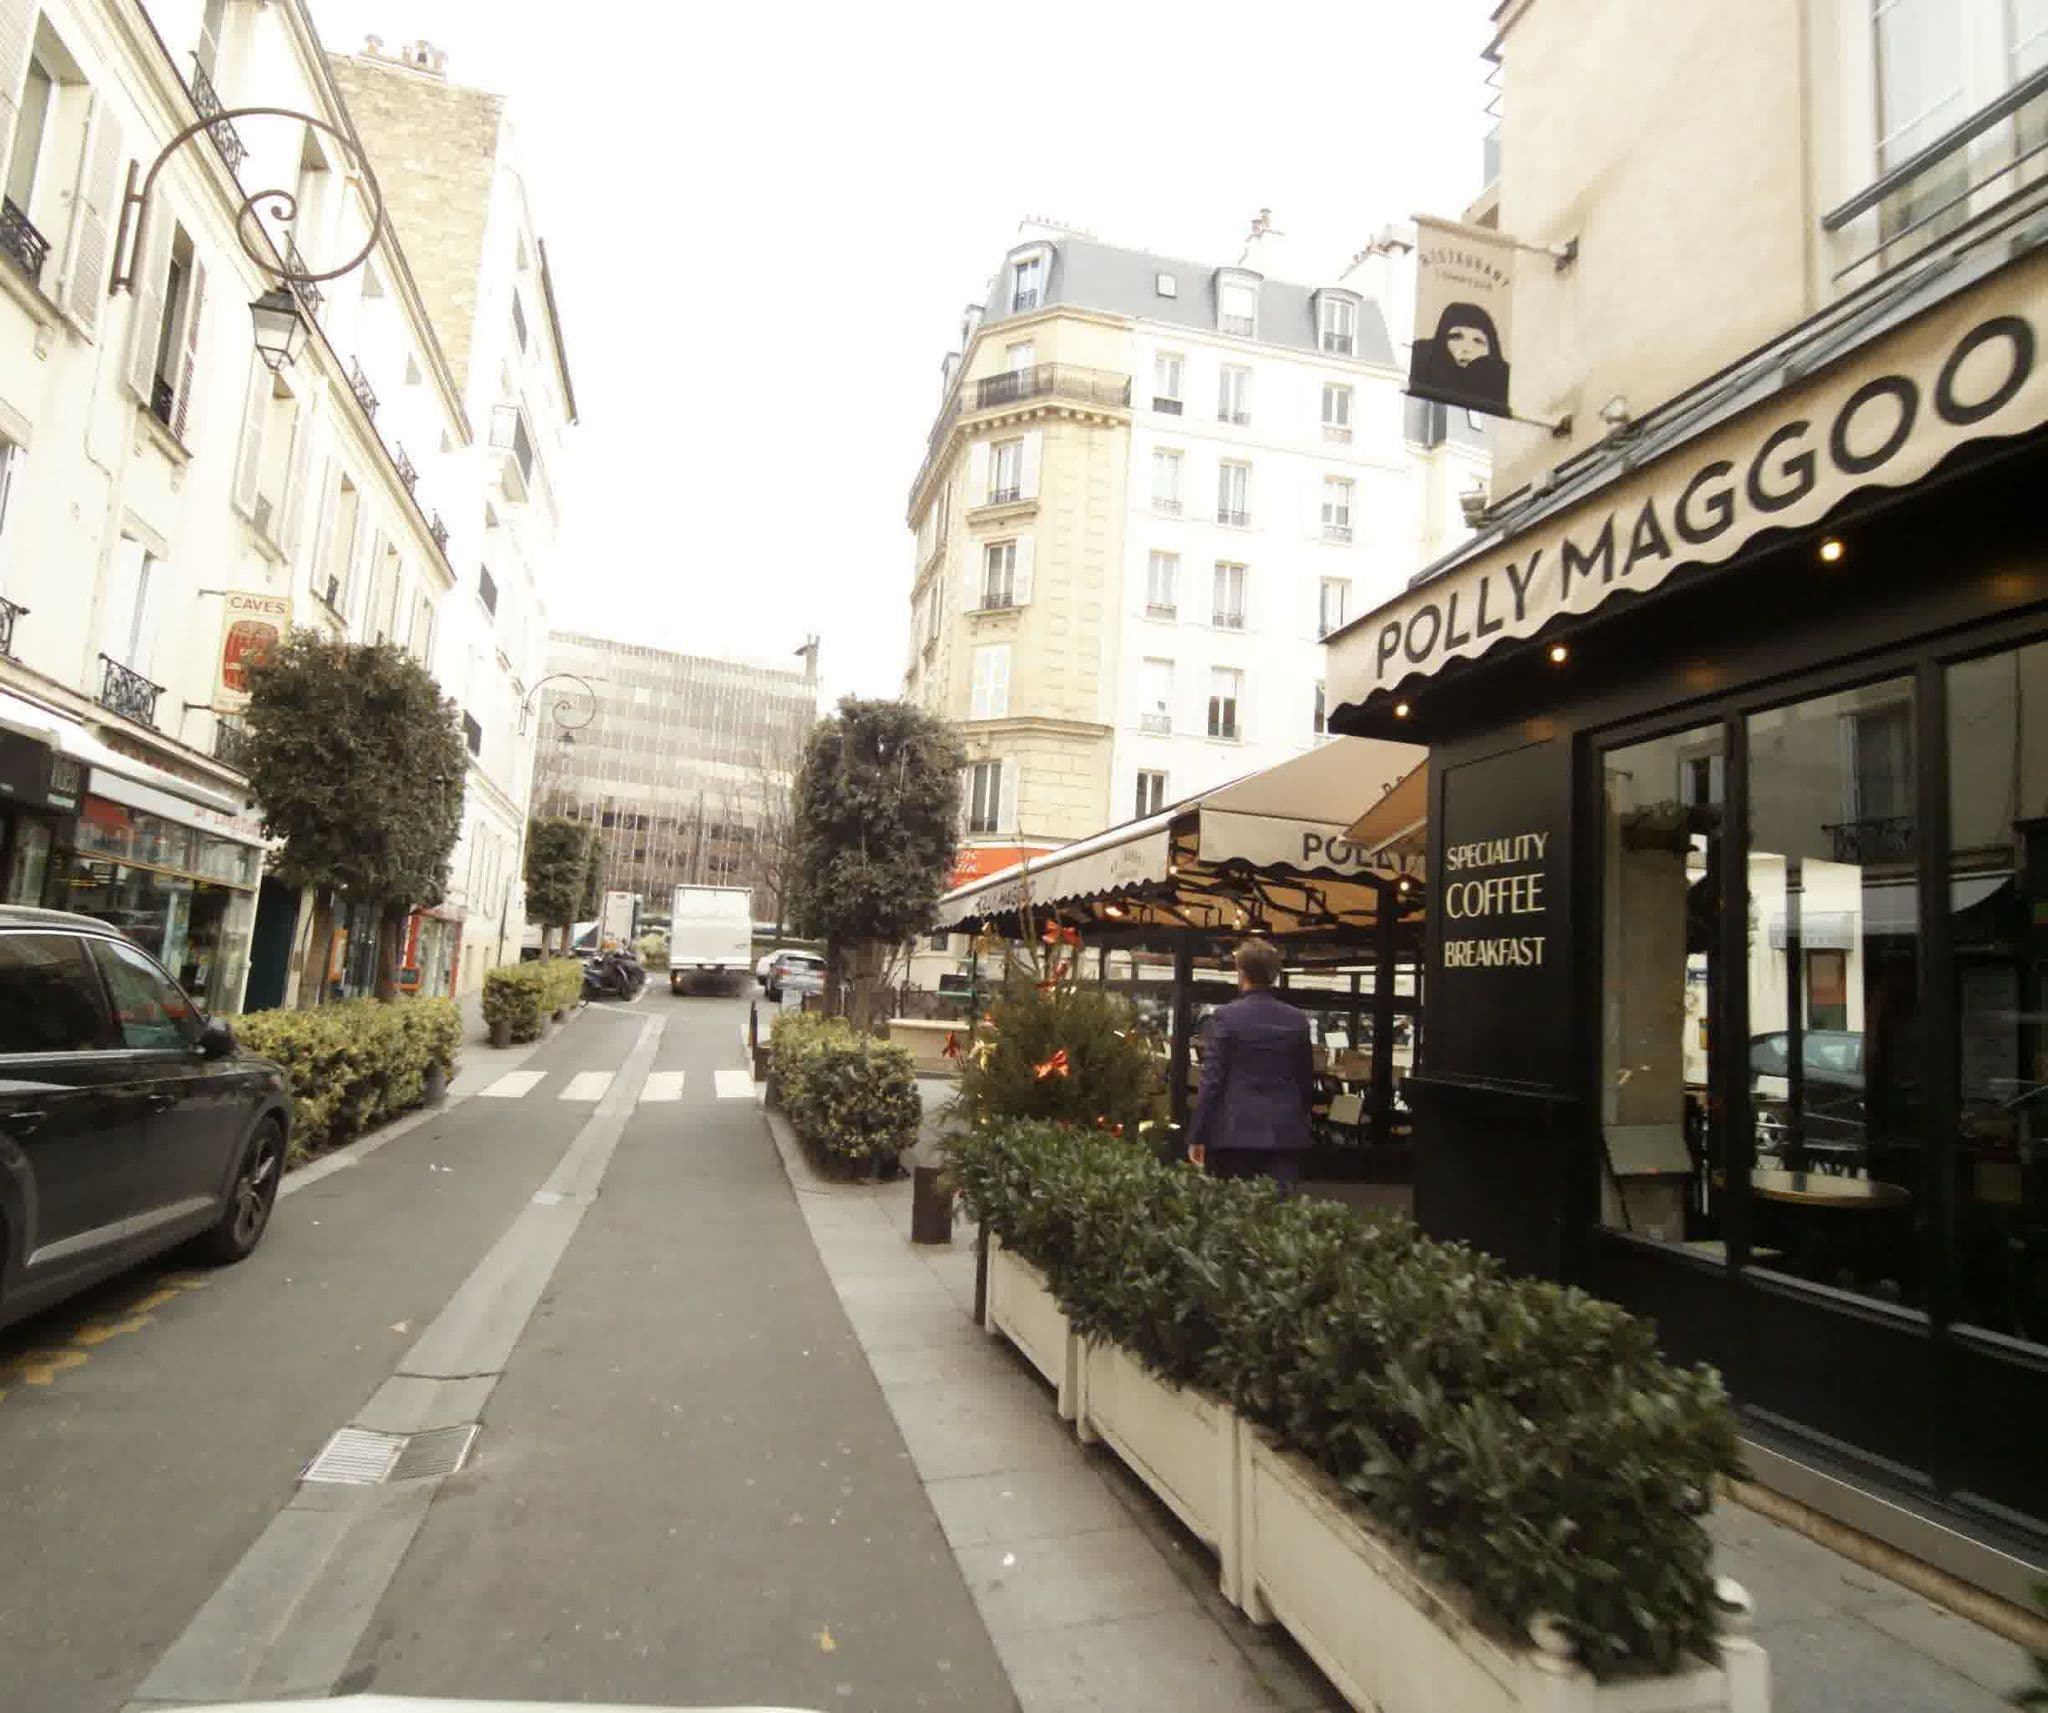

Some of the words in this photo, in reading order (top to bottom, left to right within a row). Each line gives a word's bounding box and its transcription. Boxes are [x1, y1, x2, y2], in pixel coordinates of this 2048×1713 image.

[1377, 549, 1544, 680] POLLY
[1560, 314, 2035, 601] MAGGOO
[229, 596, 285, 614] CAVES
[1446, 831, 1549, 871] SPECIALITY
[1446, 872, 1546, 919] COFFEE
[1444, 936, 1546, 968] BREAKFAST
